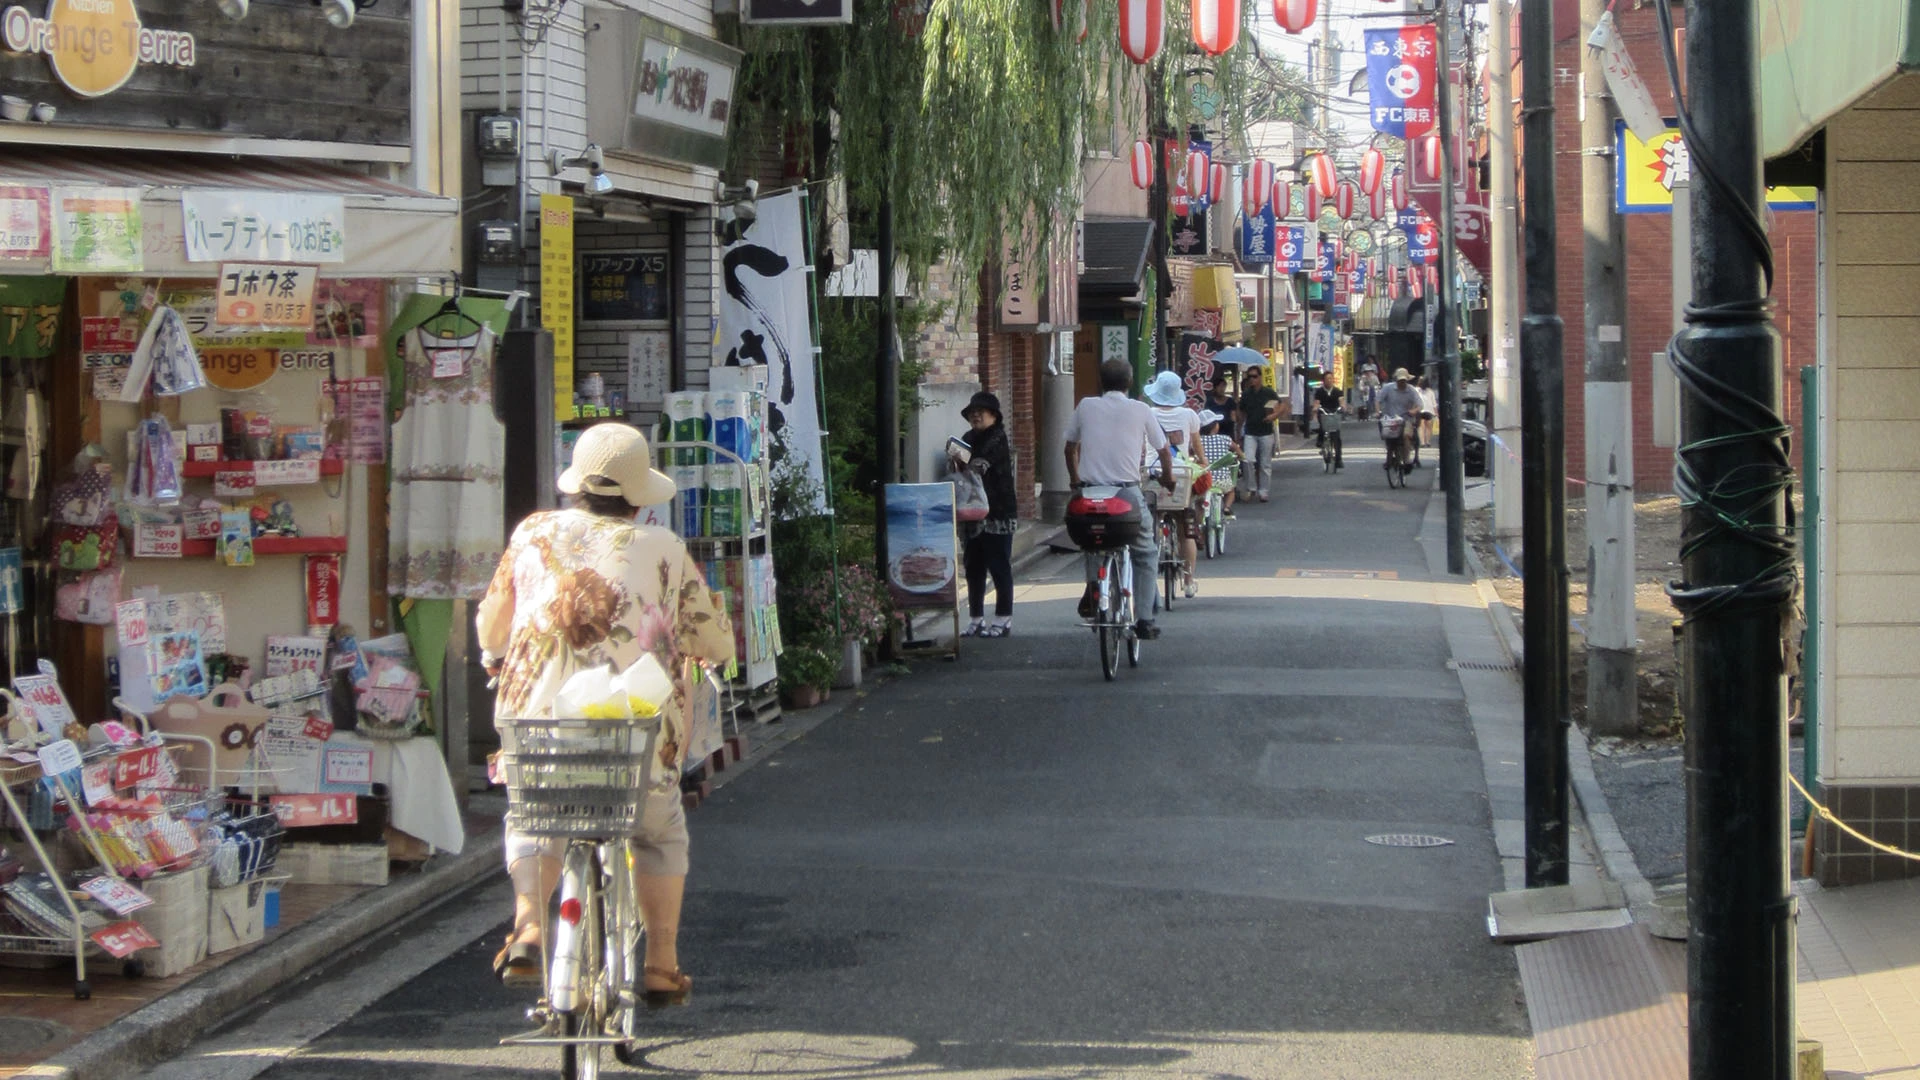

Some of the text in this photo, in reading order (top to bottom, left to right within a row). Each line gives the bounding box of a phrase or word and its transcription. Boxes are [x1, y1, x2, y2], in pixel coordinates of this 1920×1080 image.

[7, 8, 195, 66] Orange Terra
[1375, 107, 1431, 122] FC東京
[193, 217, 332, 252] ハーブティーのお店
[583, 256, 665, 272] リアップ X5
[224, 270, 299, 299] ゴボウ茶
[263, 303, 306, 320] あります
[86, 354, 132, 368] SECOM
[199, 350, 330, 374] ange Terra
[269, 645, 322, 658] ランチョンマット
[117, 752, 158, 782] セール!
